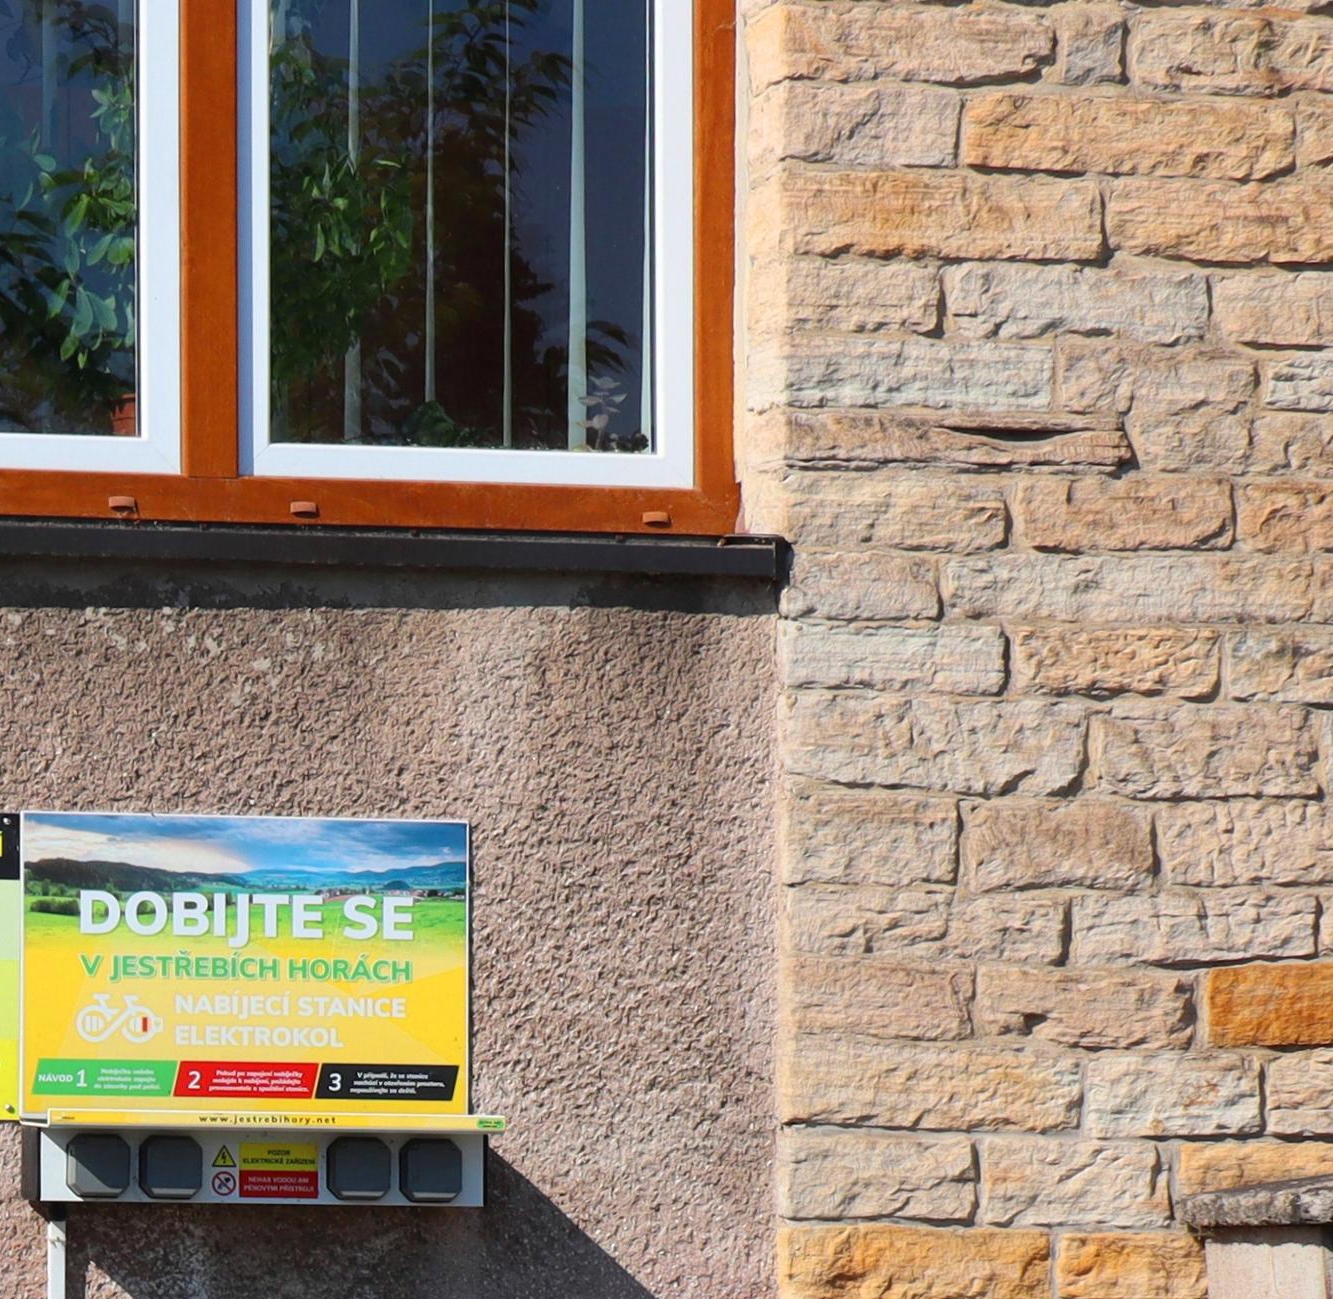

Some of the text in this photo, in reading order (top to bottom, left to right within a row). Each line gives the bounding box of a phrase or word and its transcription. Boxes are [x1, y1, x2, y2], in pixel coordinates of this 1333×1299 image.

[79, 889, 414, 948] DOBIJTE SE
[79, 950, 413, 982] V JESTŘEBÍCH HORÁCH
[175, 990, 407, 1022] NABÍJECÍ STANICE
[175, 1023, 343, 1048] ELEKTROKOL
[38, 1072, 73, 1082] NÁVOD
[76, 1069, 87, 1088] 1
[188, 1070, 201, 1089] 2
[328, 1073, 341, 1091] 3
